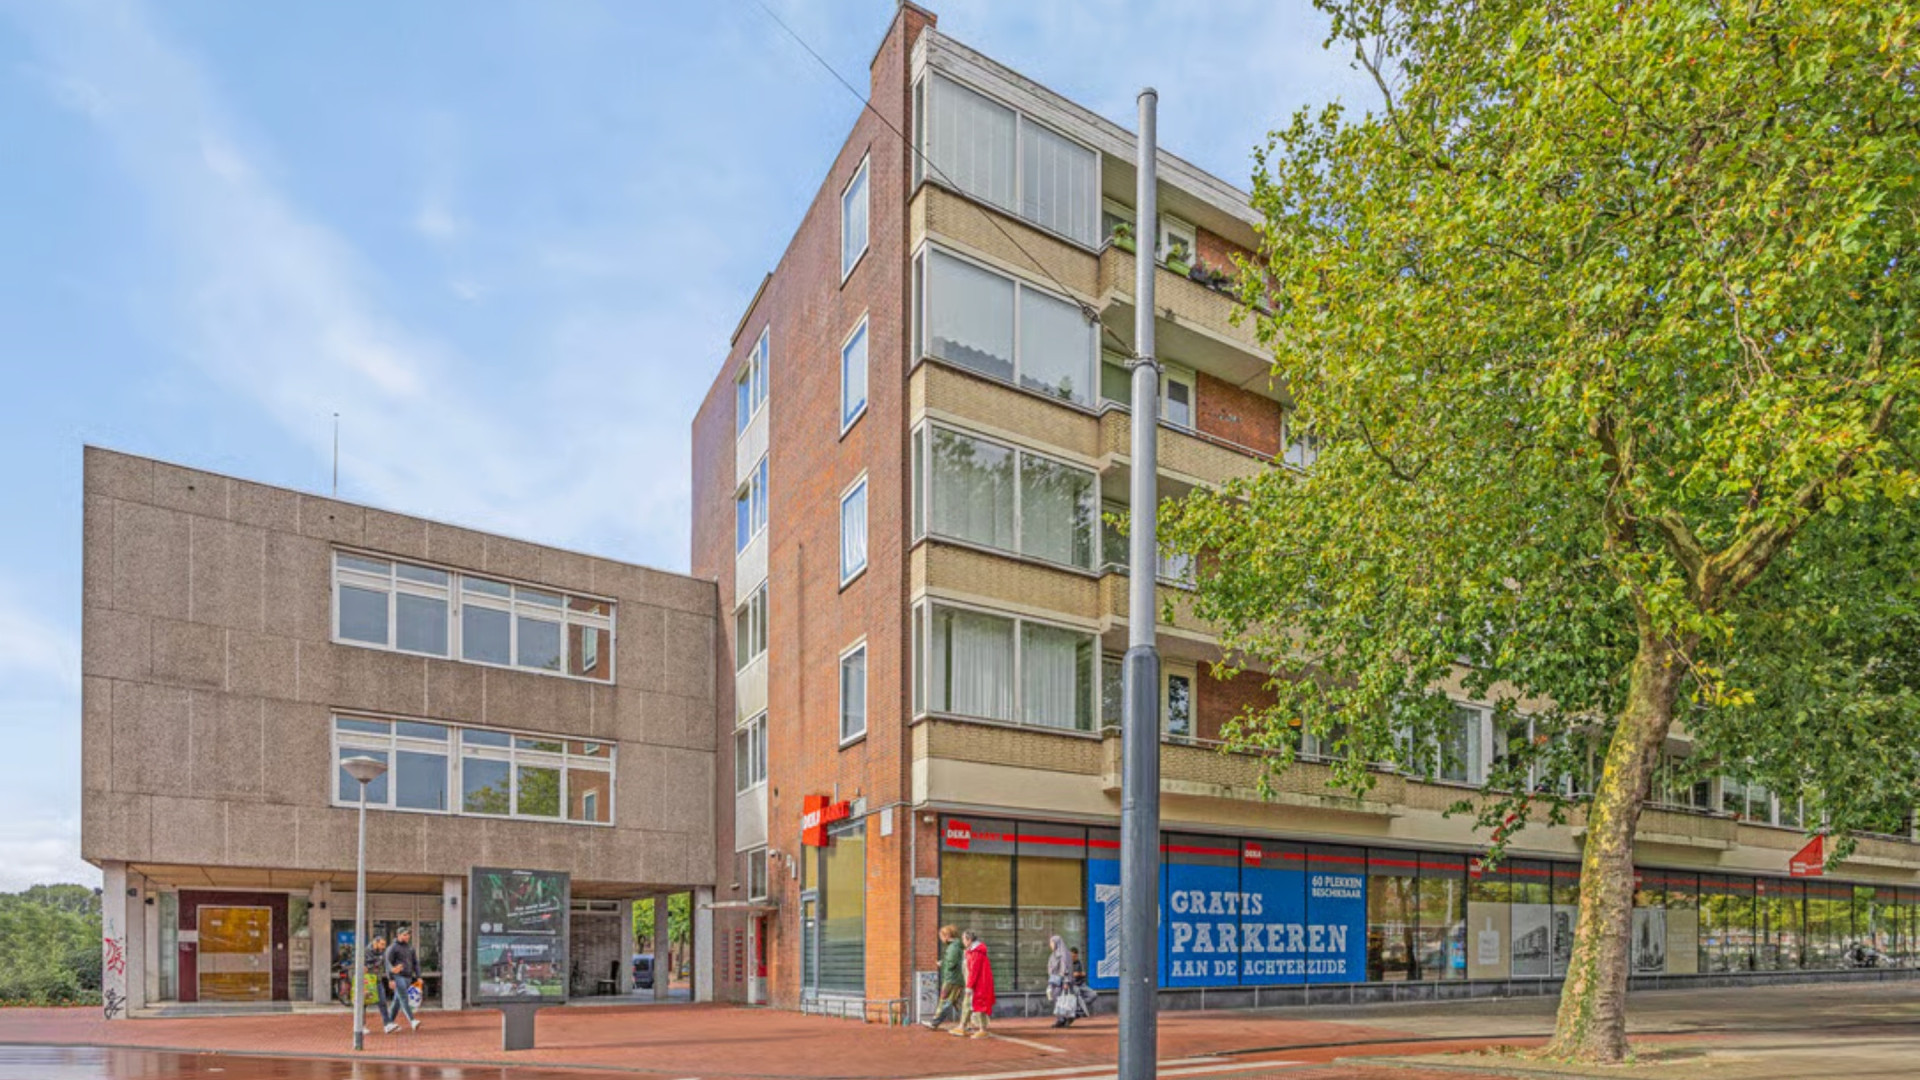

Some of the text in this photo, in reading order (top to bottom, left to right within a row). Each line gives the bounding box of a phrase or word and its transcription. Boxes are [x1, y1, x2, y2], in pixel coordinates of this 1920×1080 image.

[1312, 875, 1362, 888] 60 PLEKKEN
[1171, 890, 1263, 915] GRATIS
[1171, 922, 1348, 953] PARKEREN
[1171, 960, 1208, 977] AAN
[1213, 960, 1237, 977] DE
